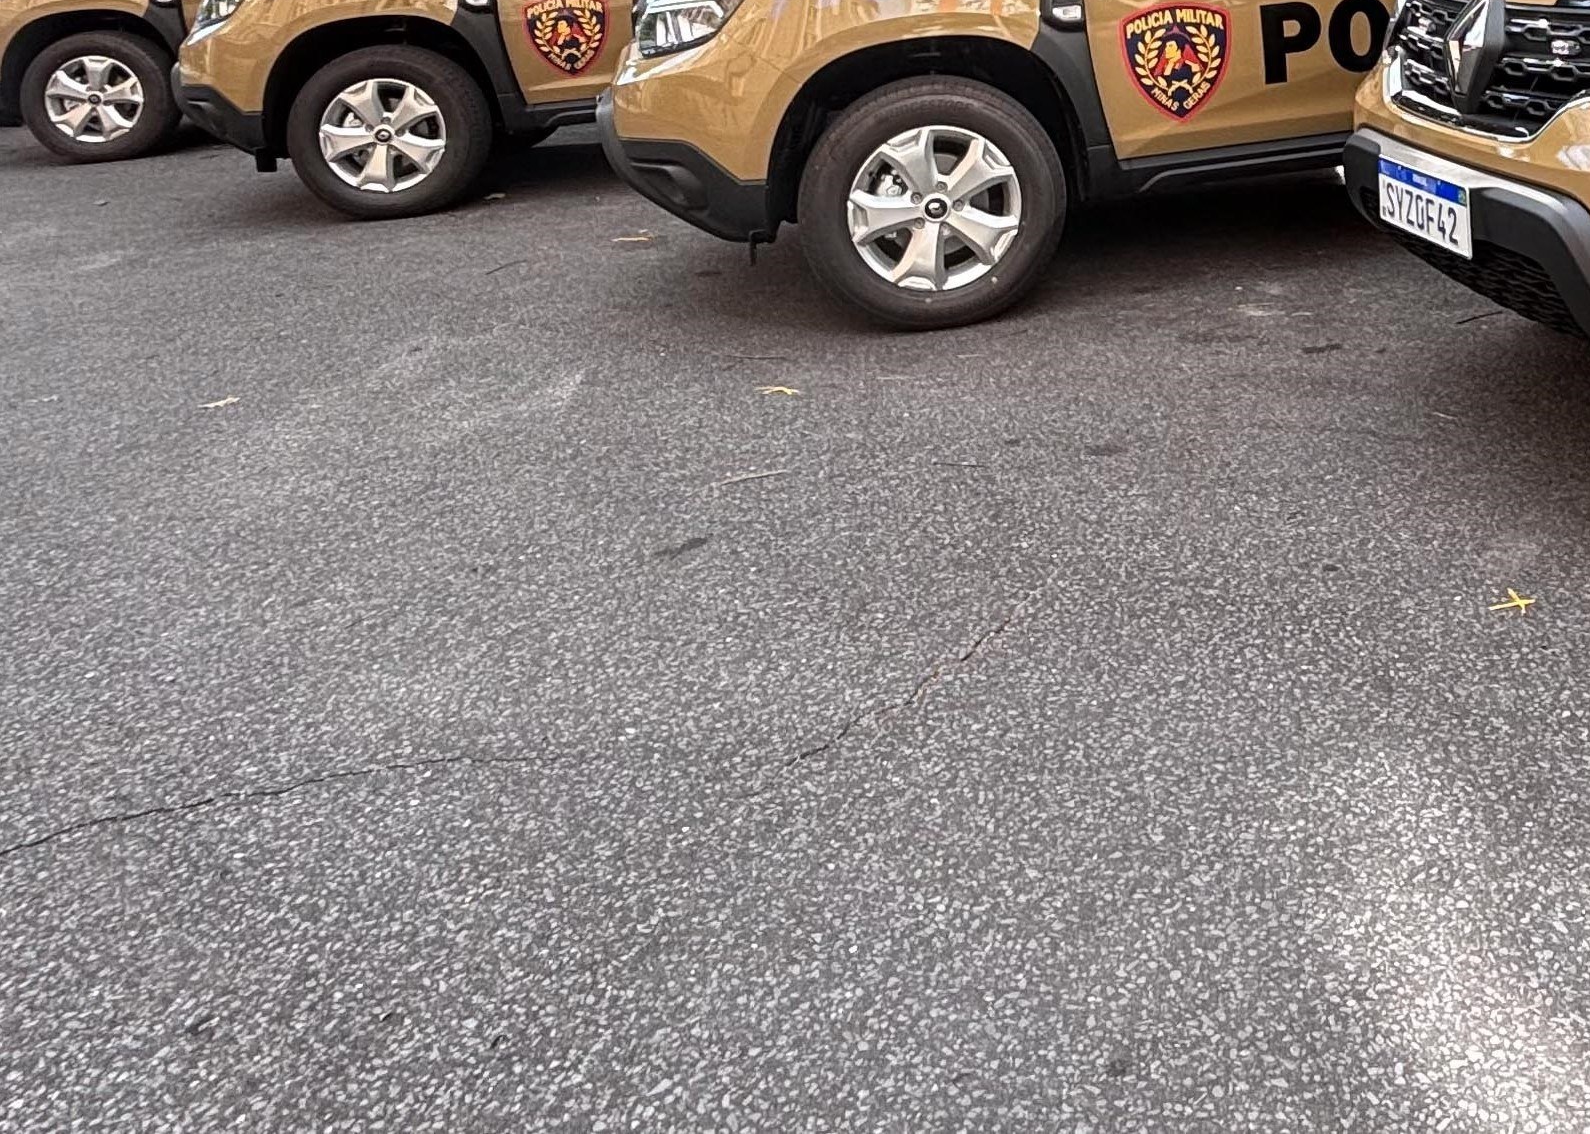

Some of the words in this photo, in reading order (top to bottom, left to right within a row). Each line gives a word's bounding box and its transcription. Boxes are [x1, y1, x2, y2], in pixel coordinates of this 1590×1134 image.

[1175, 8, 1225, 30] MILITAR
[1151, 87, 1180, 112] MINAS
[1183, 81, 1212, 110] GERAIS
